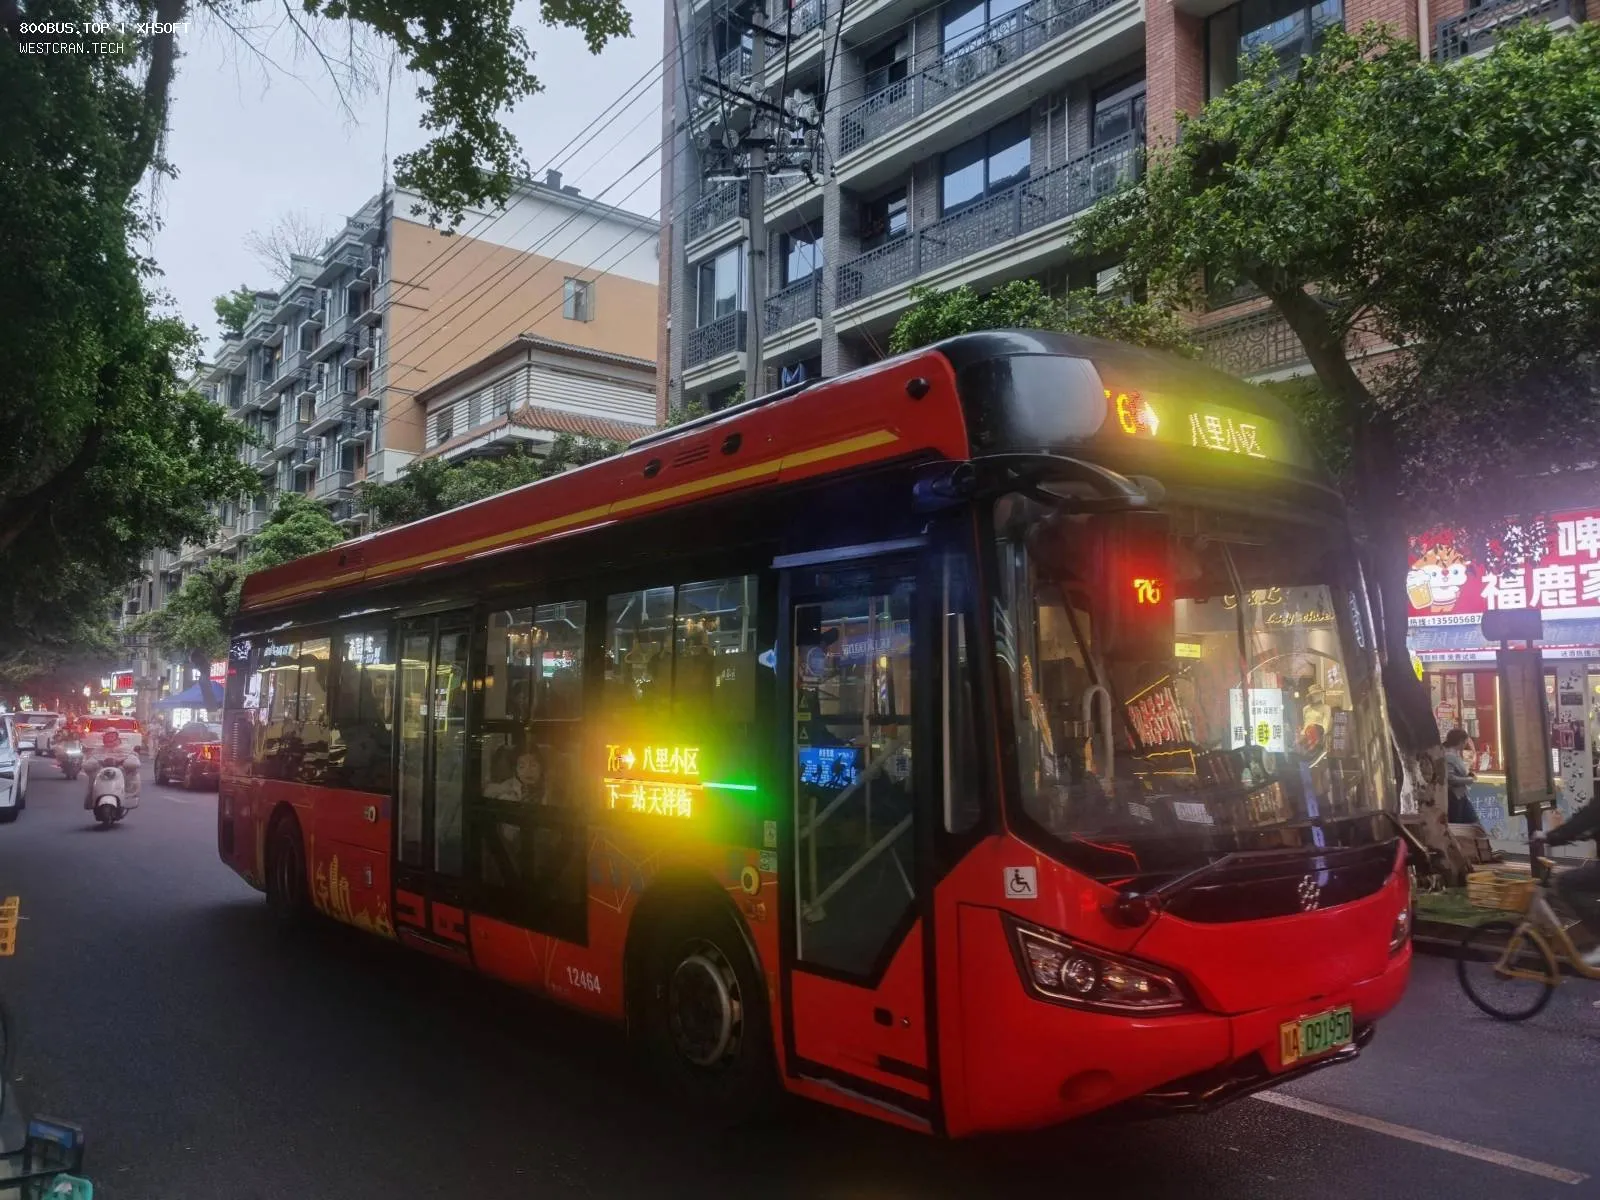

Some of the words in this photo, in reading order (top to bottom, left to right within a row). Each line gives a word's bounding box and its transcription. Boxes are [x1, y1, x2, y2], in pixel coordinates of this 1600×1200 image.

[1188, 412, 1266, 458] 八里小区
[1133, 578, 1160, 604] 76
[642, 745, 700, 775] 八里小区
[566, 965, 601, 994] 12464
